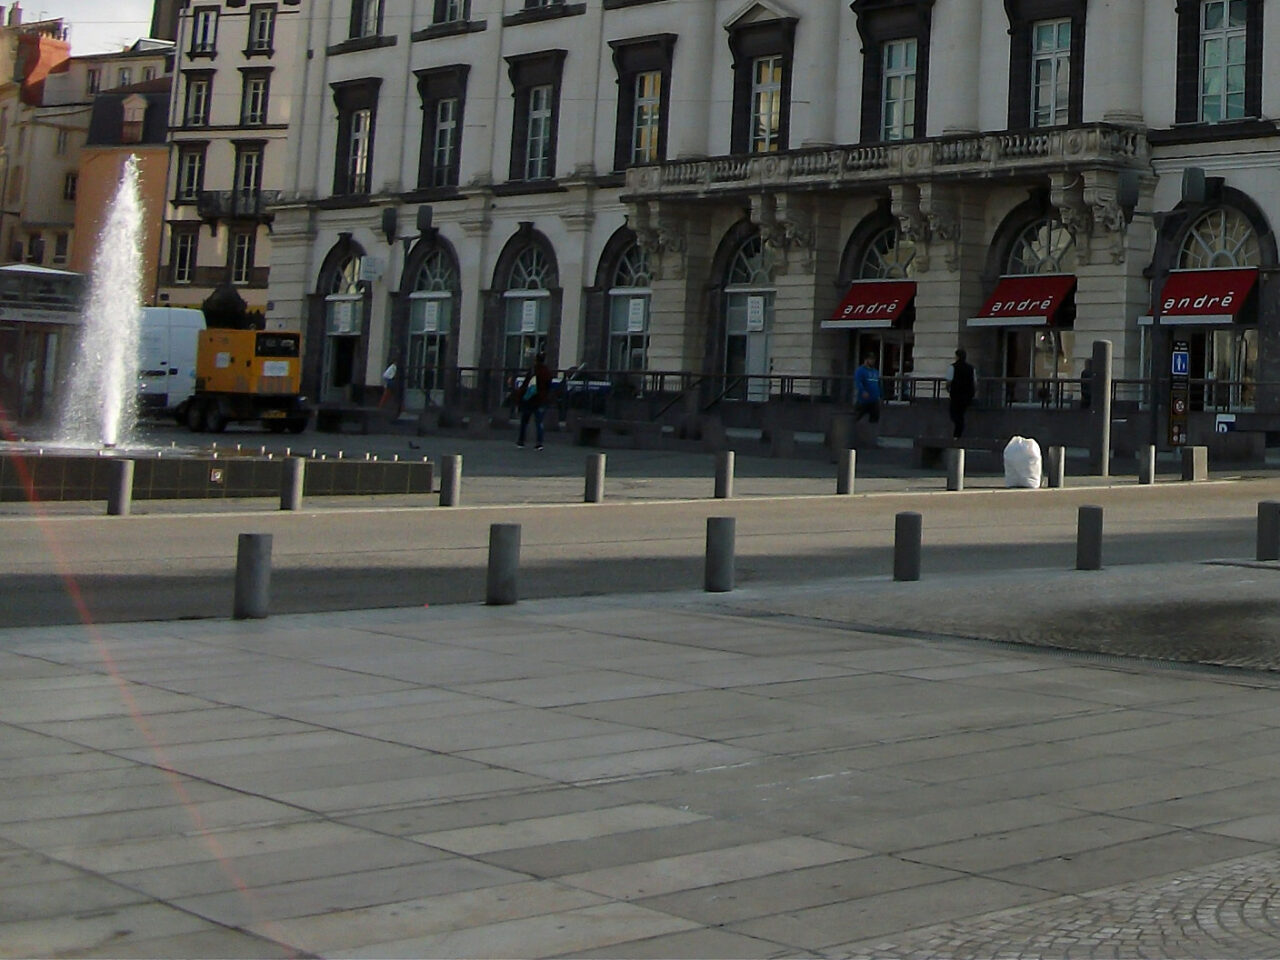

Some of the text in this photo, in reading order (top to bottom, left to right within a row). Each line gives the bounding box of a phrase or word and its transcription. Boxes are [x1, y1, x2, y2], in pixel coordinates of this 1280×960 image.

[841, 299, 899, 318] andré
[989, 295, 1054, 315] andré
[1162, 291, 1235, 313] andré
